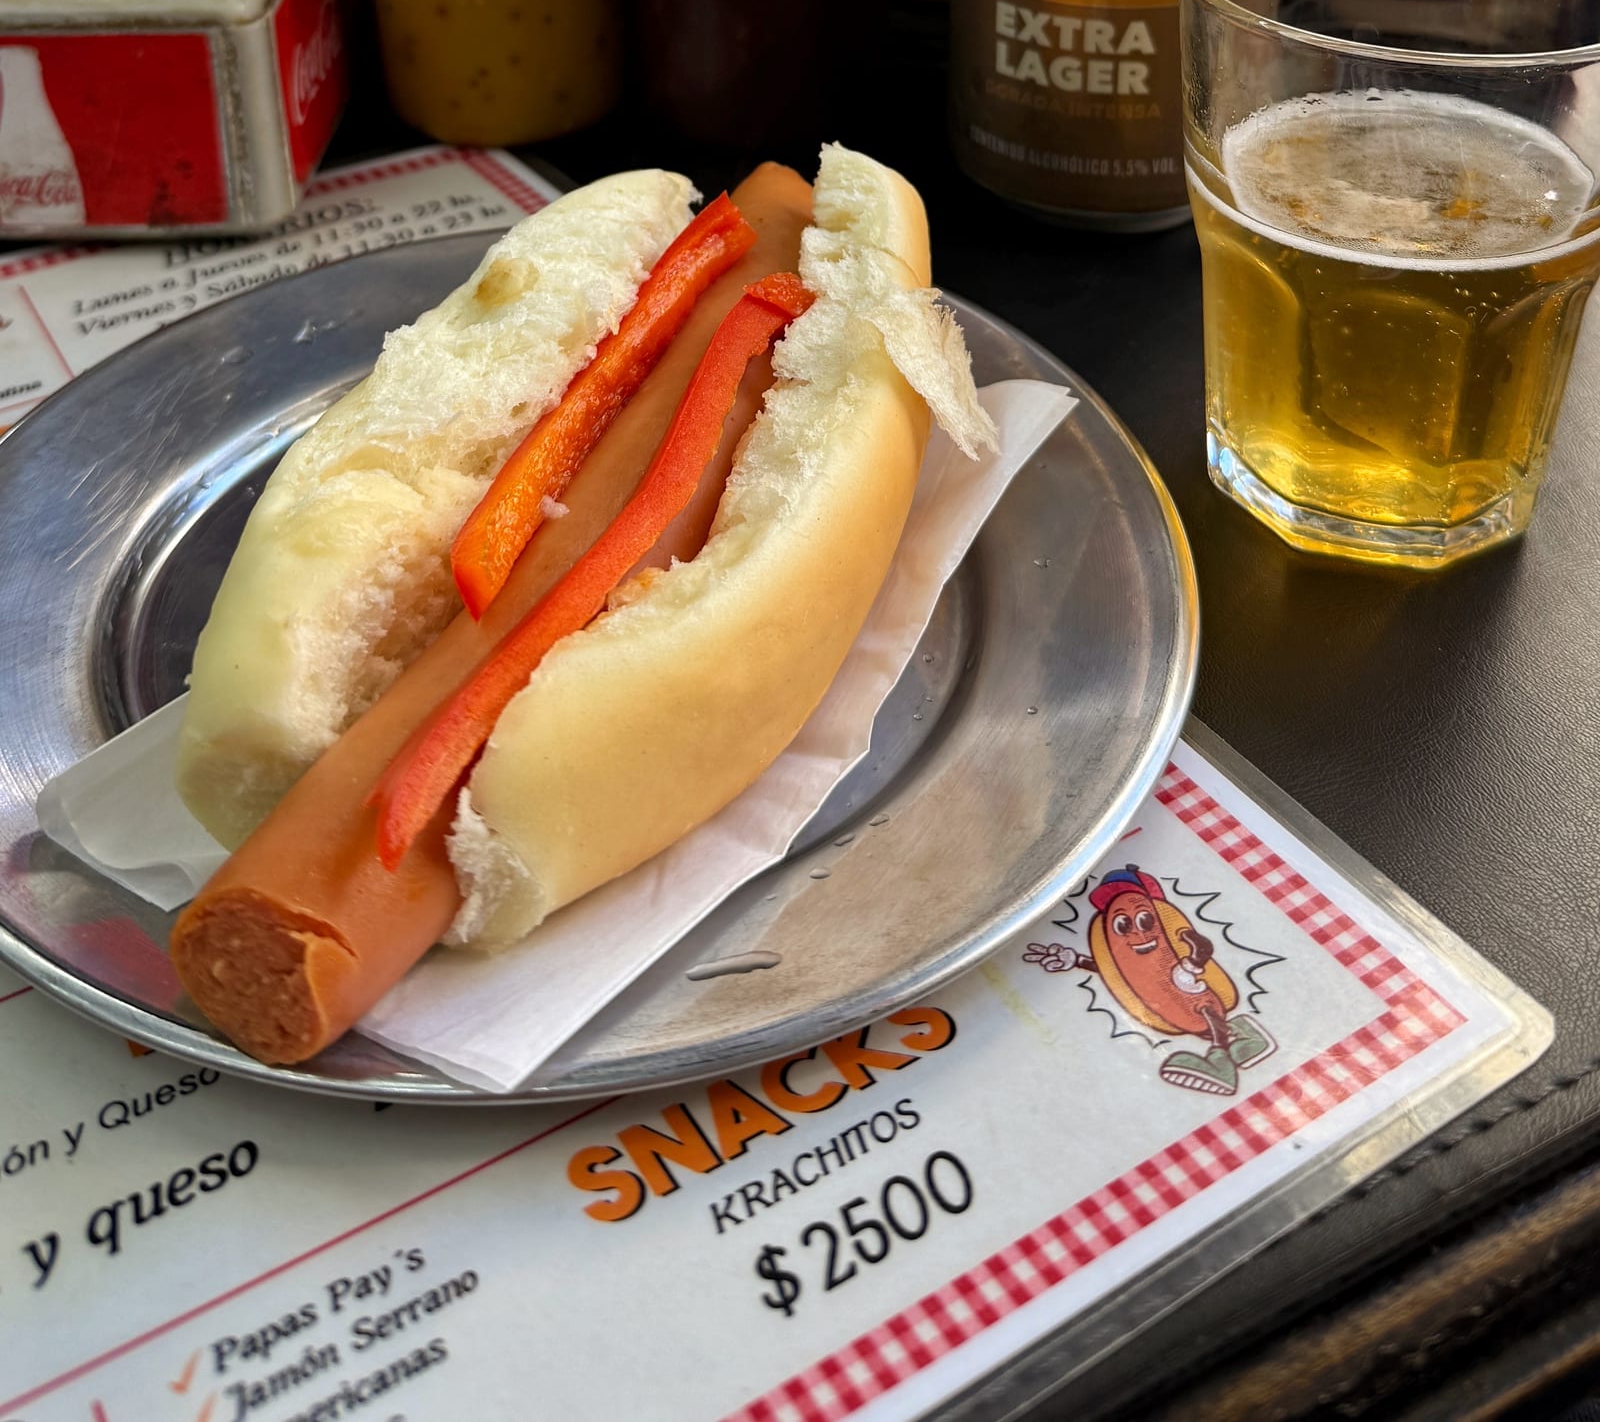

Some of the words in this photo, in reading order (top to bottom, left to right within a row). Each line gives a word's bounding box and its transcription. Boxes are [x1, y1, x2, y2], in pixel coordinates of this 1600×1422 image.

[995, 0, 1156, 56] EXTRA
[995, 40, 1149, 96] LAGER
[164, 197, 382, 269] HORIOS:
[274, 239, 302, 257] de
[74, 296, 177, 337] Viernes
[0, 1138, 50, 1176] ón
[62, 1120, 85, 1158] y
[97, 1066, 222, 1130] Queso
[567, 1006, 957, 1224] SNACKS
[708, 1097, 922, 1236] KRACHITOS
[23, 1230, 61, 1292] y
[85, 1139, 260, 1257] queso
[211, 1299, 318, 1375] Papas
[225, 1344, 342, 1422] Jamón
[348, 1267, 480, 1353] Serrano
[285, 1336, 449, 1422] ericanas
